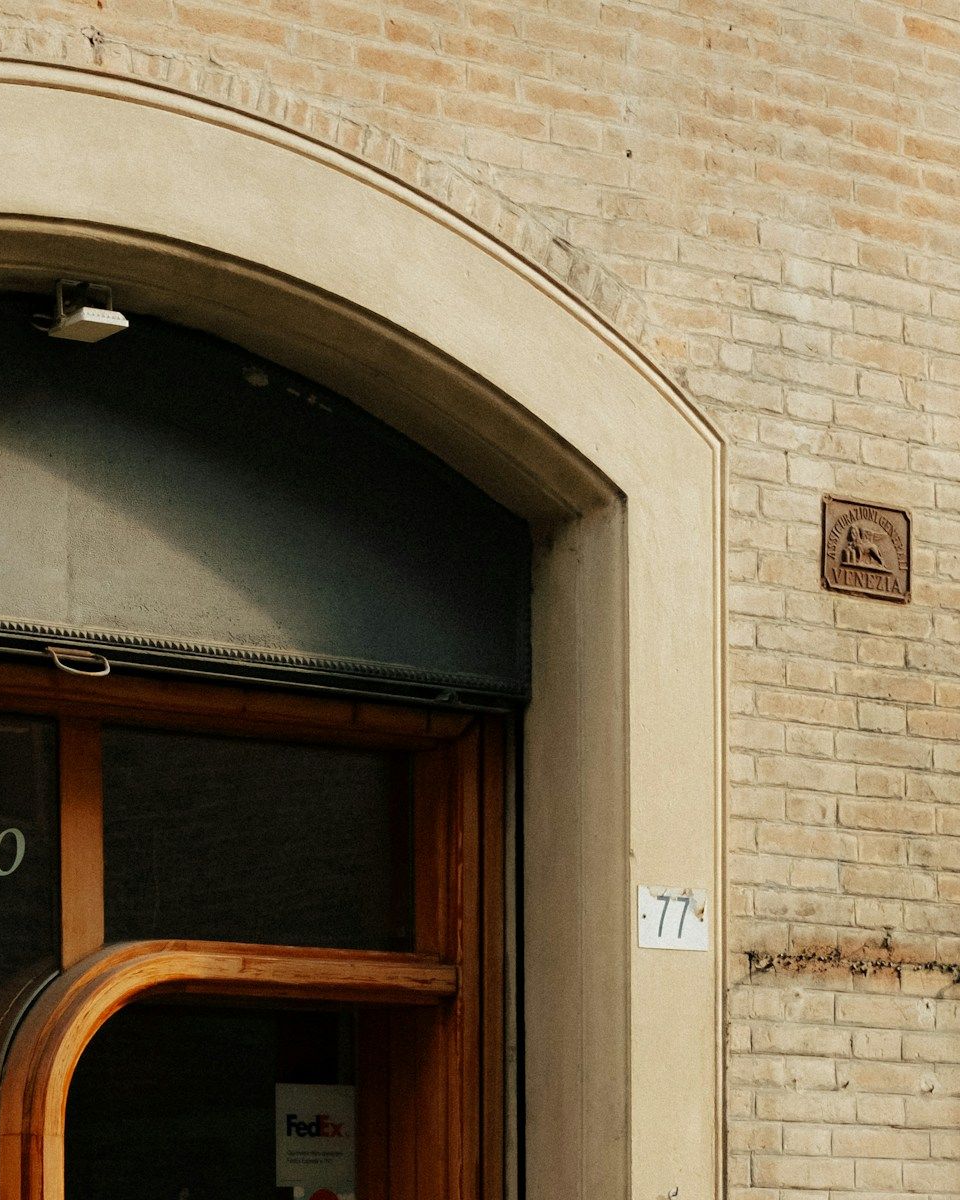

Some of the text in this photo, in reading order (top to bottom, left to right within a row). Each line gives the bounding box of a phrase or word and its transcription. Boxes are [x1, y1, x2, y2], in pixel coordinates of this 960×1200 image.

[827, 507, 878, 559] ASSICURAZIONI
[832, 568, 902, 593] VENEZIA
[657, 896, 691, 939] 77
[286, 1114, 344, 1137] FedEx
